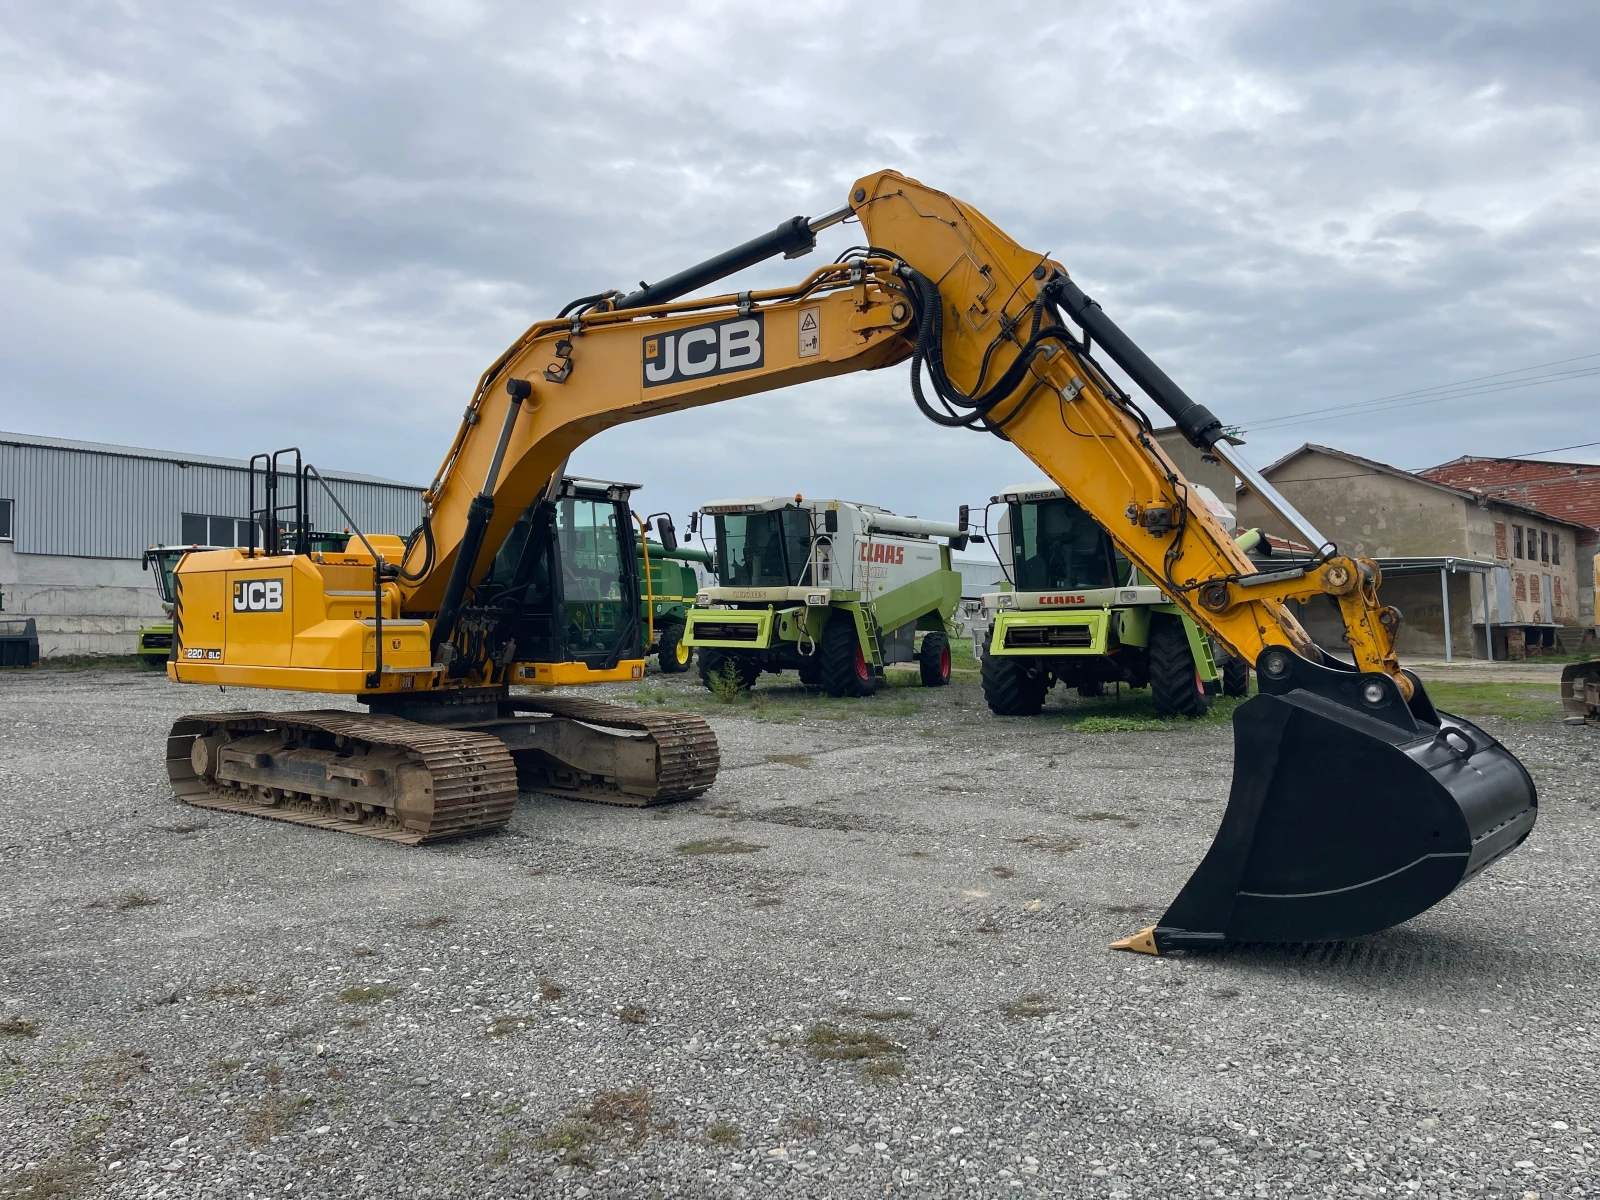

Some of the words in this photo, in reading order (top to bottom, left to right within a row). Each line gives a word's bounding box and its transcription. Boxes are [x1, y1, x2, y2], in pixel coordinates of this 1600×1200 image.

[646, 319, 761, 381] JCB
[1024, 491, 1057, 500] MEGA
[858, 541, 904, 565] CLAAS
[234, 581, 282, 610] JCB
[732, 590, 767, 599] LEXION
[1038, 595, 1085, 605] CLAAS
[187, 648, 208, 659] 220X
[208, 651, 221, 659] SLC
